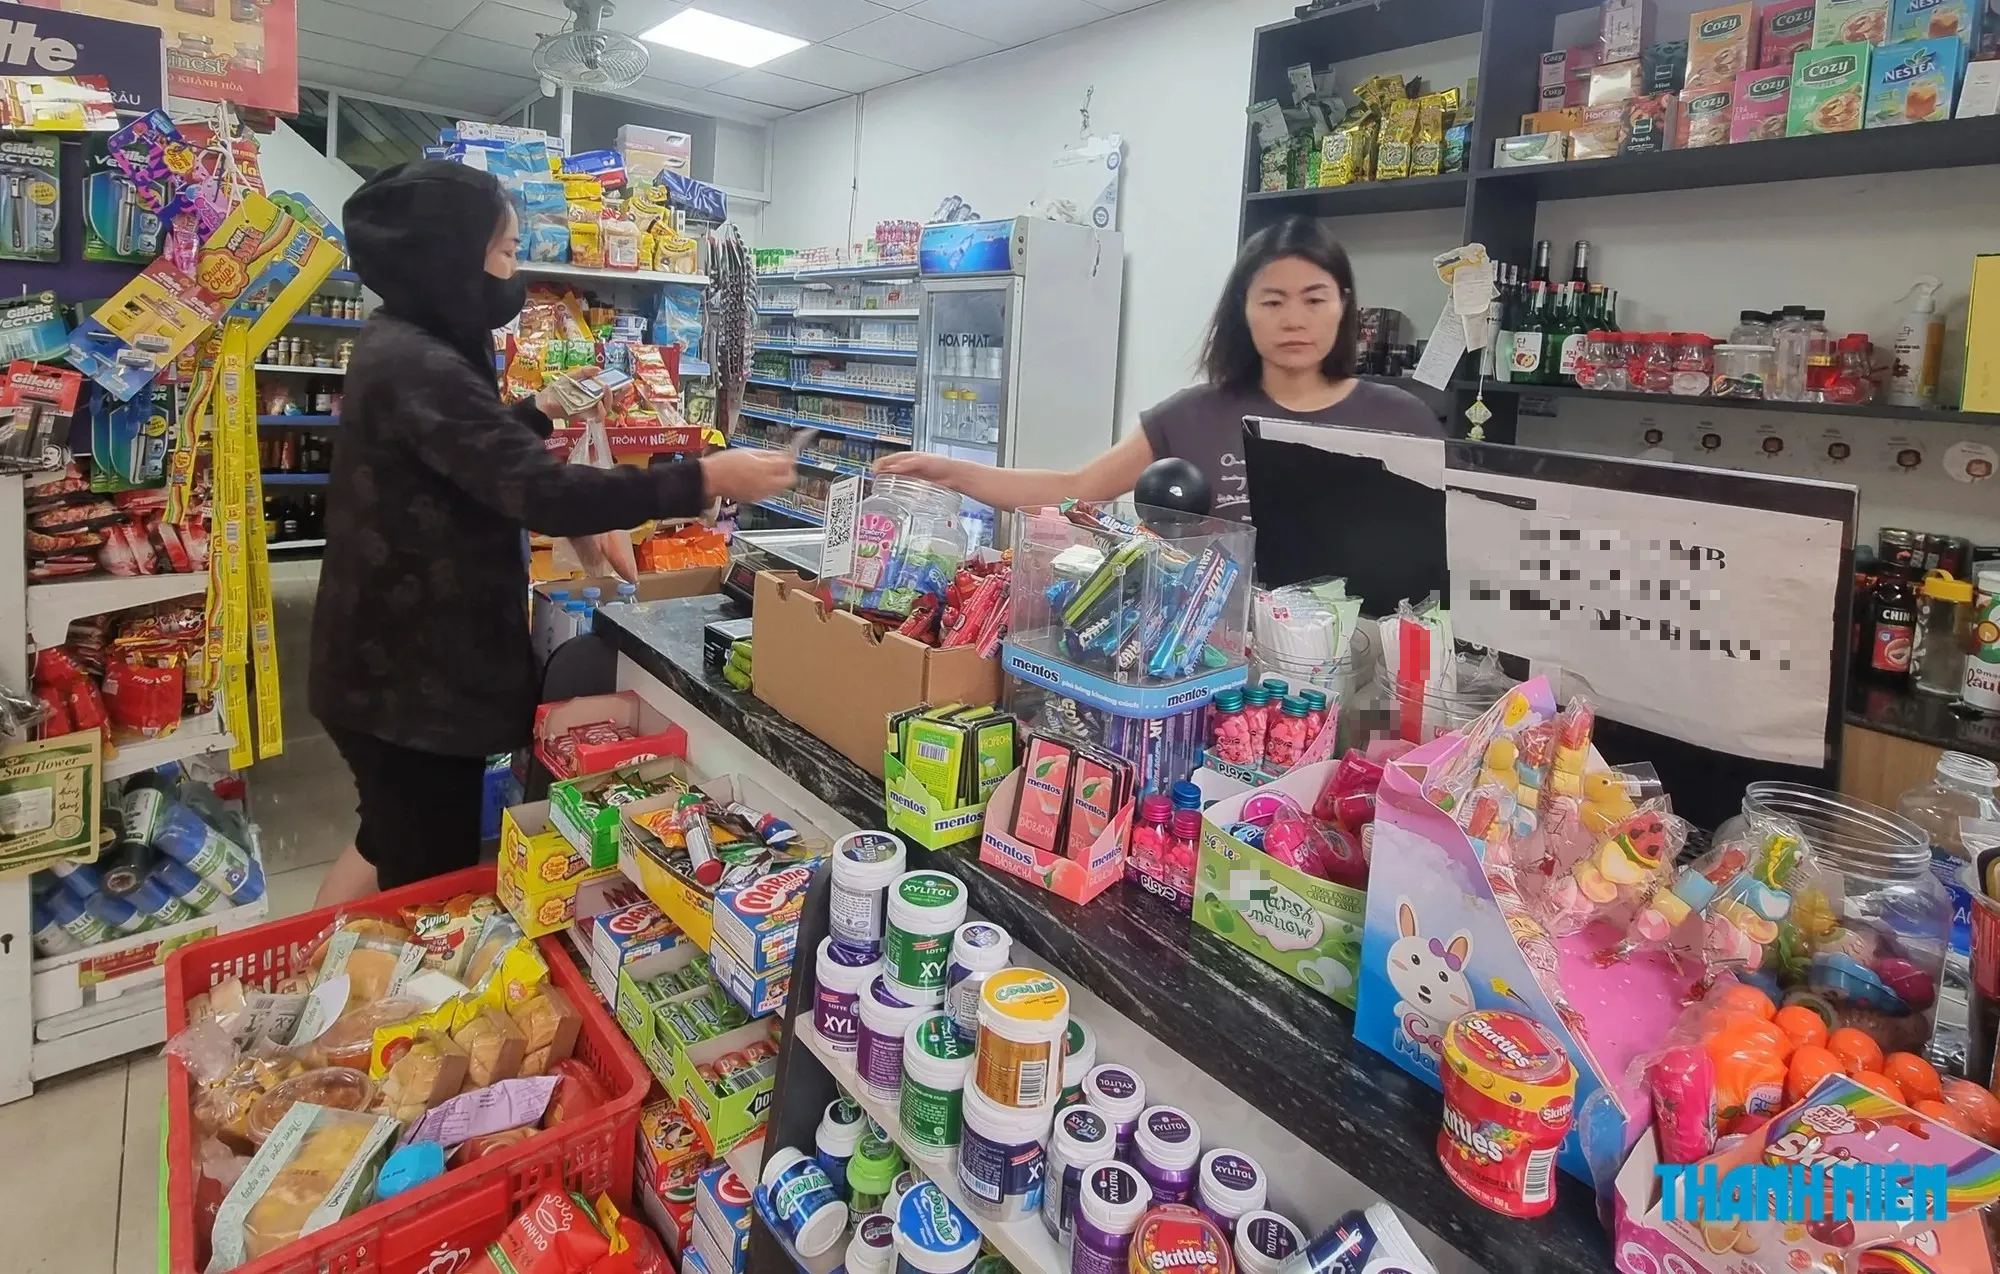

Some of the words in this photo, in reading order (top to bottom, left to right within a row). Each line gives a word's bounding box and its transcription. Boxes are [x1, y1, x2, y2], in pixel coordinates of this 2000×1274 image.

[1703, 17, 1737, 34] Cozy
[1776, 10, 1813, 27] Cozy
[1543, 53, 1565, 63] Cozy
[1808, 60, 1849, 77] Cozy
[1884, 62, 1936, 82] NESTEA
[1543, 88, 1564, 97] Cozy
[1753, 80, 1785, 93] Cozy
[1692, 95, 1725, 110] Cozy
[202, 257, 226, 282] Chupa
[210, 264, 235, 291] Chups
[11, 372, 63, 390] Gillette
[612, 435, 636, 445] TRÒN
[1012, 656, 1060, 683] mentos
[1167, 686, 1208, 707] mentos
[3, 766, 30, 778] Sun
[34, 756, 79, 774] flower
[1027, 777, 1061, 795] mentos
[890, 790, 927, 815] mentos
[1075, 798, 1107, 819] mentos
[935, 811, 985, 831] mentos
[985, 833, 1033, 865] mentos
[1091, 845, 1122, 869] mentos
[904, 884, 953, 898] XYLITOL
[416, 911, 450, 936] Swing
[926, 946, 947, 955] LOTTE
[828, 1002, 847, 1012] LOTTE
[1467, 1018, 1531, 1070] Skittles
[1100, 1078, 1134, 1090] XYLITOL
[1816, 1106, 1853, 1126] FRUIT
[1152, 1122, 1188, 1132] XYLITOL
[1442, 1101, 1503, 1163] kittles
[1215, 1164, 1254, 1181] XYLITOL
[1109, 1169, 1119, 1203] XYLITOL
[1267, 1220, 1278, 1256] XYLITOL
[1151, 1248, 1218, 1271] Skittles
